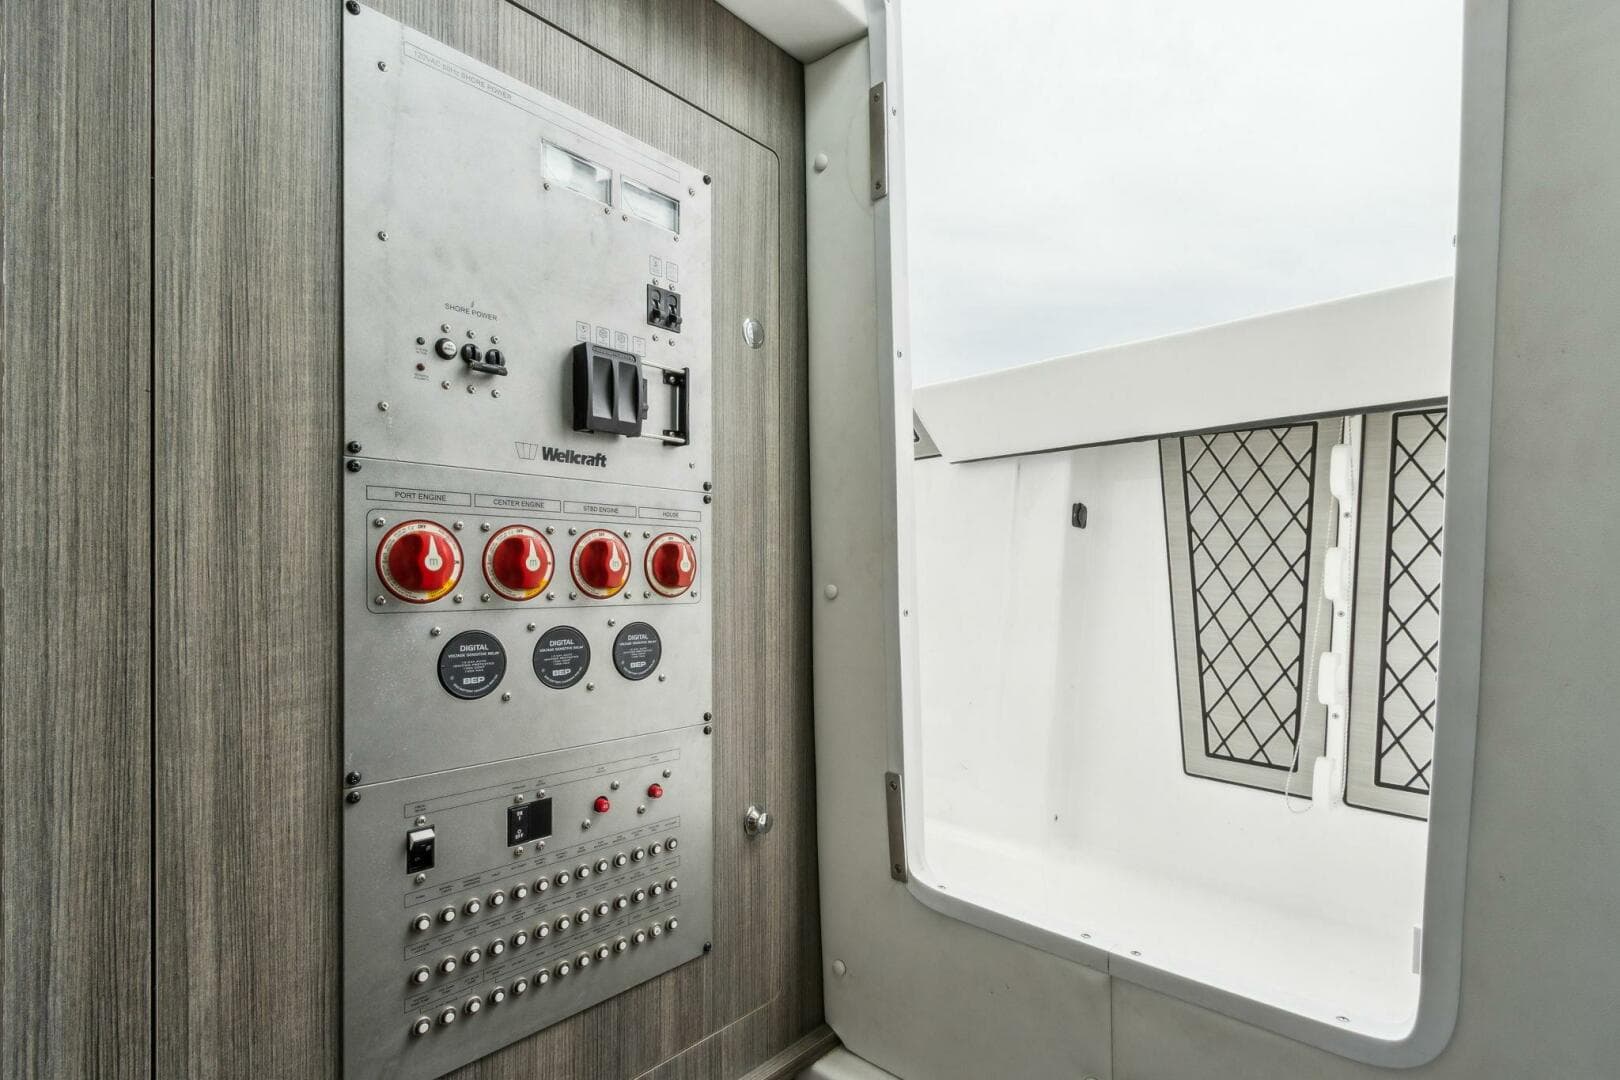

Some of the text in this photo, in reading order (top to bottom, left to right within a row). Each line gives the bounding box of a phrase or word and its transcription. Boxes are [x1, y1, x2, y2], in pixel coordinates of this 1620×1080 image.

[444, 302, 499, 322] SHORE POWER
[541, 446, 607, 468] Wellcraft
[394, 491, 446, 502] PORT ENGINE
[493, 499, 545, 509] CENTER ENGINE
[627, 633, 648, 641] DIGITAL
[549, 639, 575, 647] DIGITAL
[460, 644, 489, 652] DIGITAL
[630, 661, 646, 669] BEP
[552, 668, 571, 677] BEP
[463, 676, 485, 685] BEP
